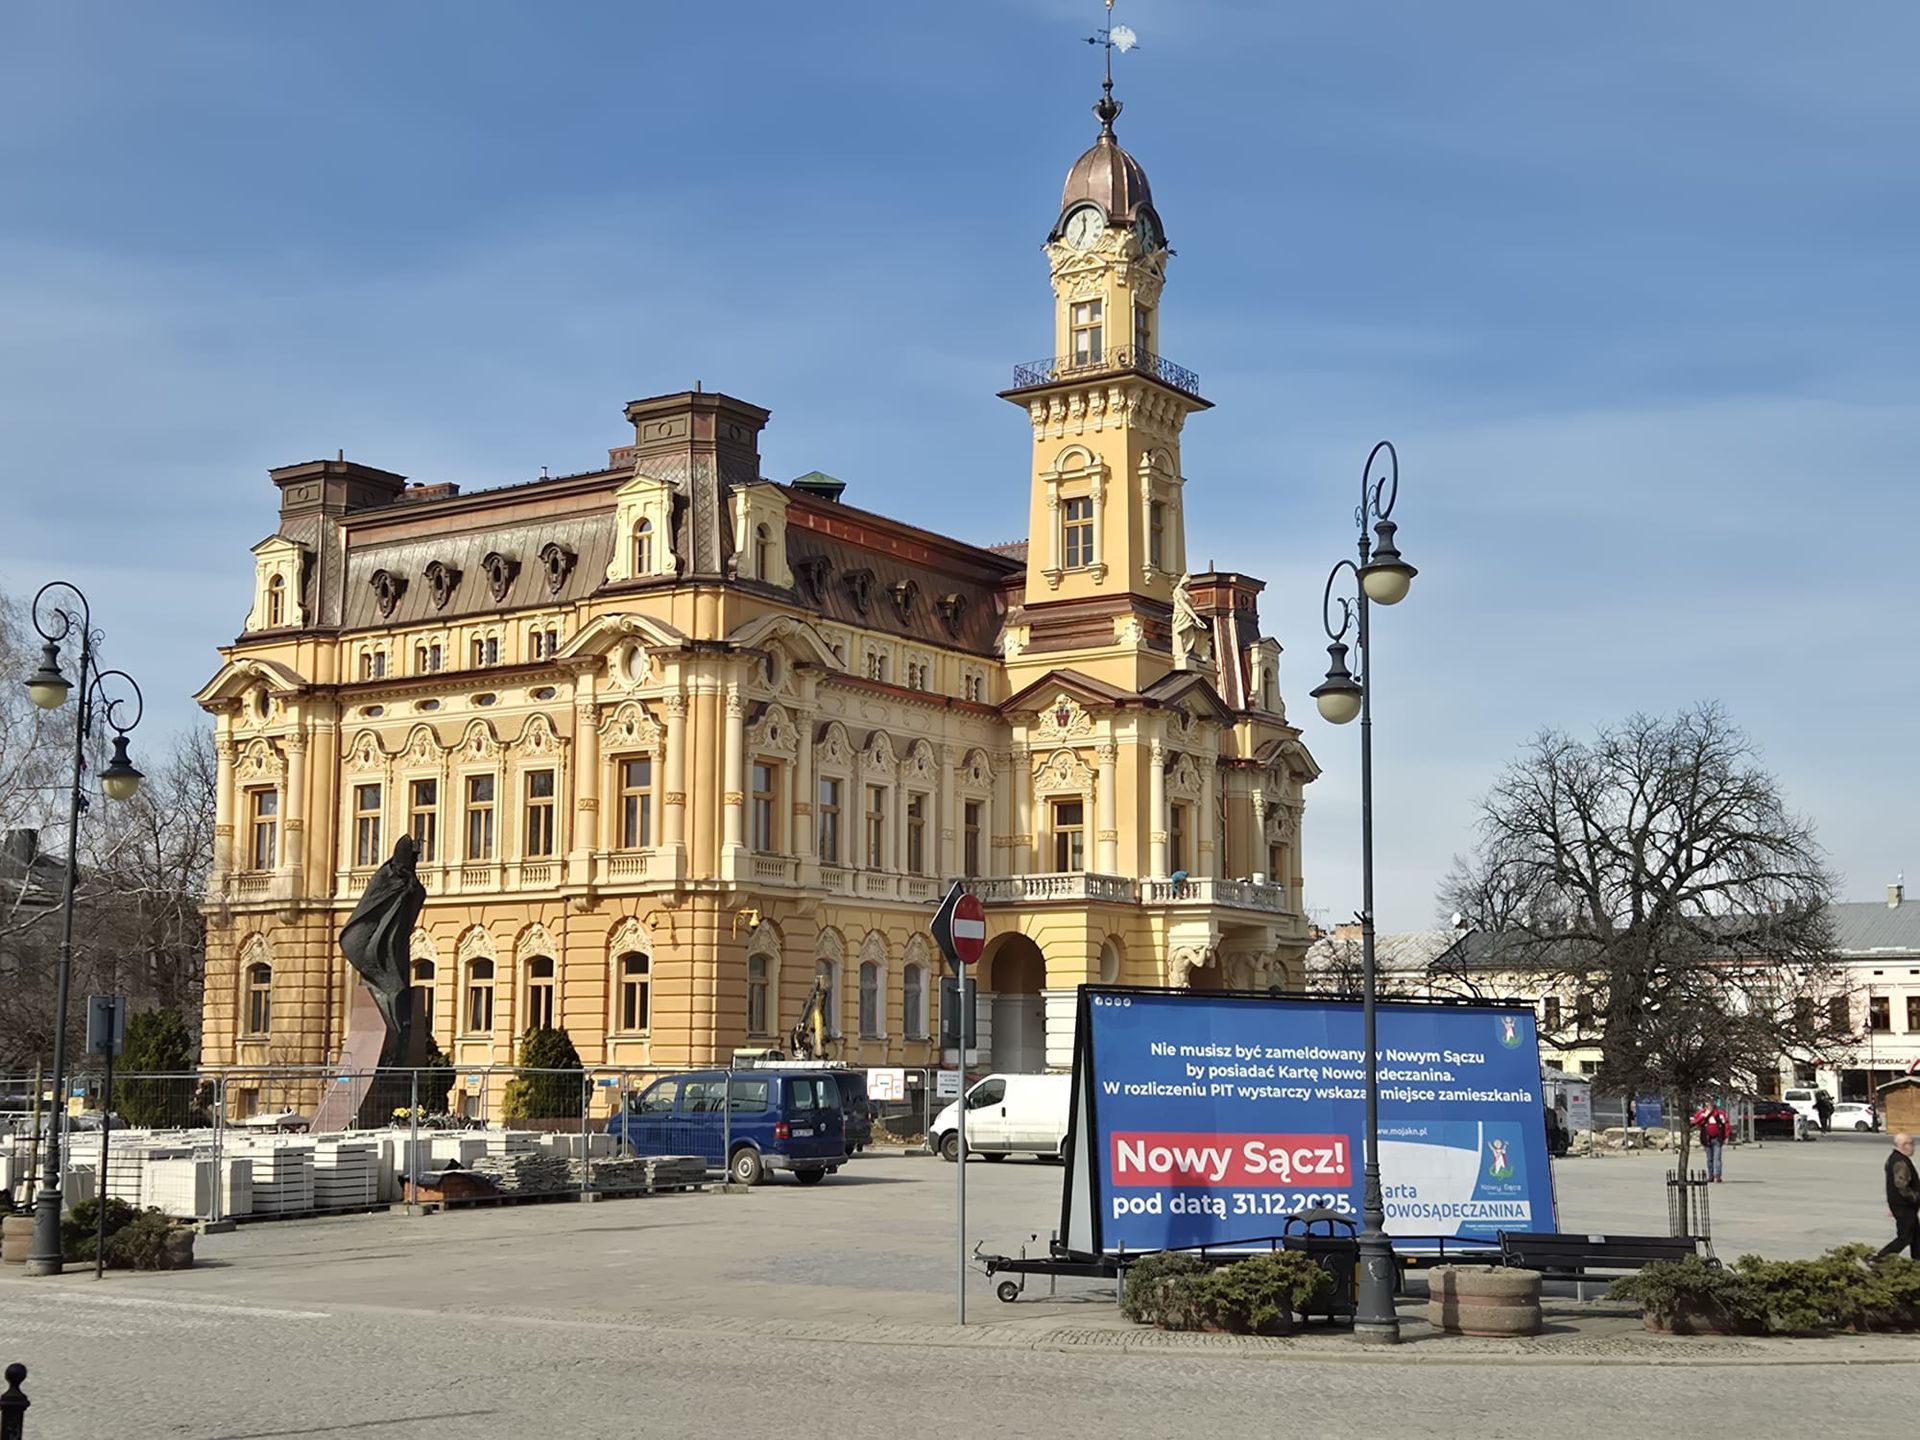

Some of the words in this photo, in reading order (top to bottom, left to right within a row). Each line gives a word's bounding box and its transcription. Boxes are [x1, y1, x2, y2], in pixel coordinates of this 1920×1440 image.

[1151, 1042, 1176, 1056] Nie
[1180, 1043, 1232, 1058] musisz
[1235, 1045, 1261, 1061] być
[1265, 1045, 1366, 1063] zameldowany
[1386, 1049, 1440, 1065] Nowym
[1444, 1050, 1485, 1066] Sączu
[1186, 1063, 1205, 1079] by
[1209, 1064, 1275, 1080] posiadać
[1279, 1065, 1319, 1082] Kartę
[1103, 1081, 1120, 1095] W
[1124, 1081, 1206, 1097] rozliczeniu
[1211, 1084, 1234, 1097] PIT
[1237, 1085, 1312, 1101] wystarczy
[1315, 1085, 1367, 1100] wskaza
[1380, 1086, 1435, 1103] miejsce
[1438, 1088, 1532, 1103] zamieszkania
[1117, 1140, 1232, 1182] Nowy
[1243, 1141, 1345, 1184] Sącz!
[1381, 1183, 1418, 1199] arta
[1113, 1192, 1162, 1219] pod
[1169, 1192, 1227, 1220] datą
[1232, 1193, 1357, 1215] 31.12.2025.
[1386, 1203, 1526, 1222] OWOSĄDECZANINA
